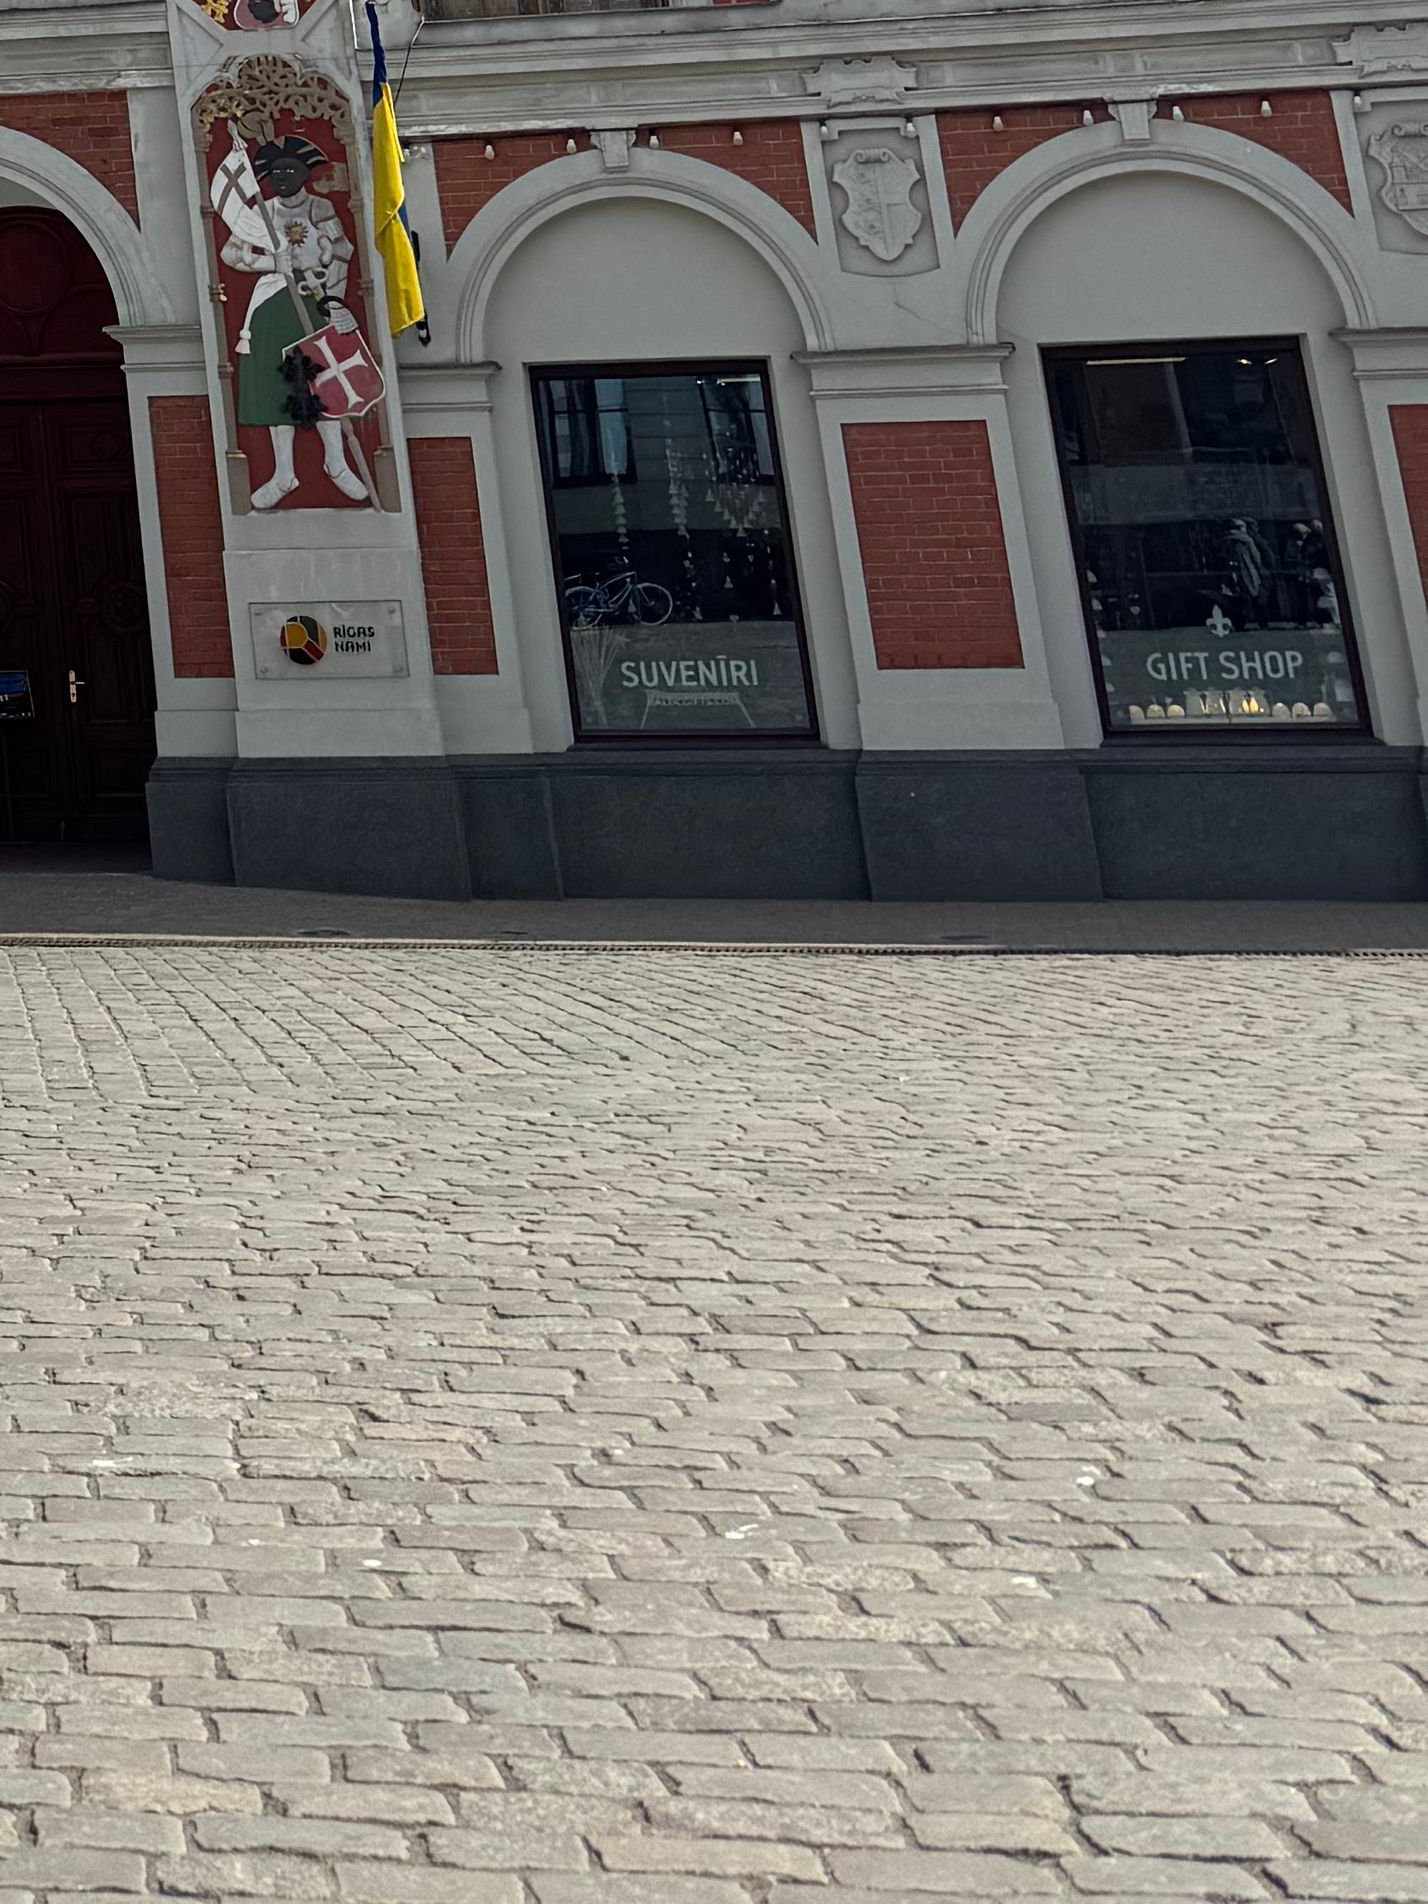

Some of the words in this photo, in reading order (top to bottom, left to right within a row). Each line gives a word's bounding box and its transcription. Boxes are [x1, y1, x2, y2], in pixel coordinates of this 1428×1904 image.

[620, 654, 760, 688] SUVENĪRI
[1146, 650, 1212, 682] GIFT
[1219, 650, 1304, 679] SHOP
